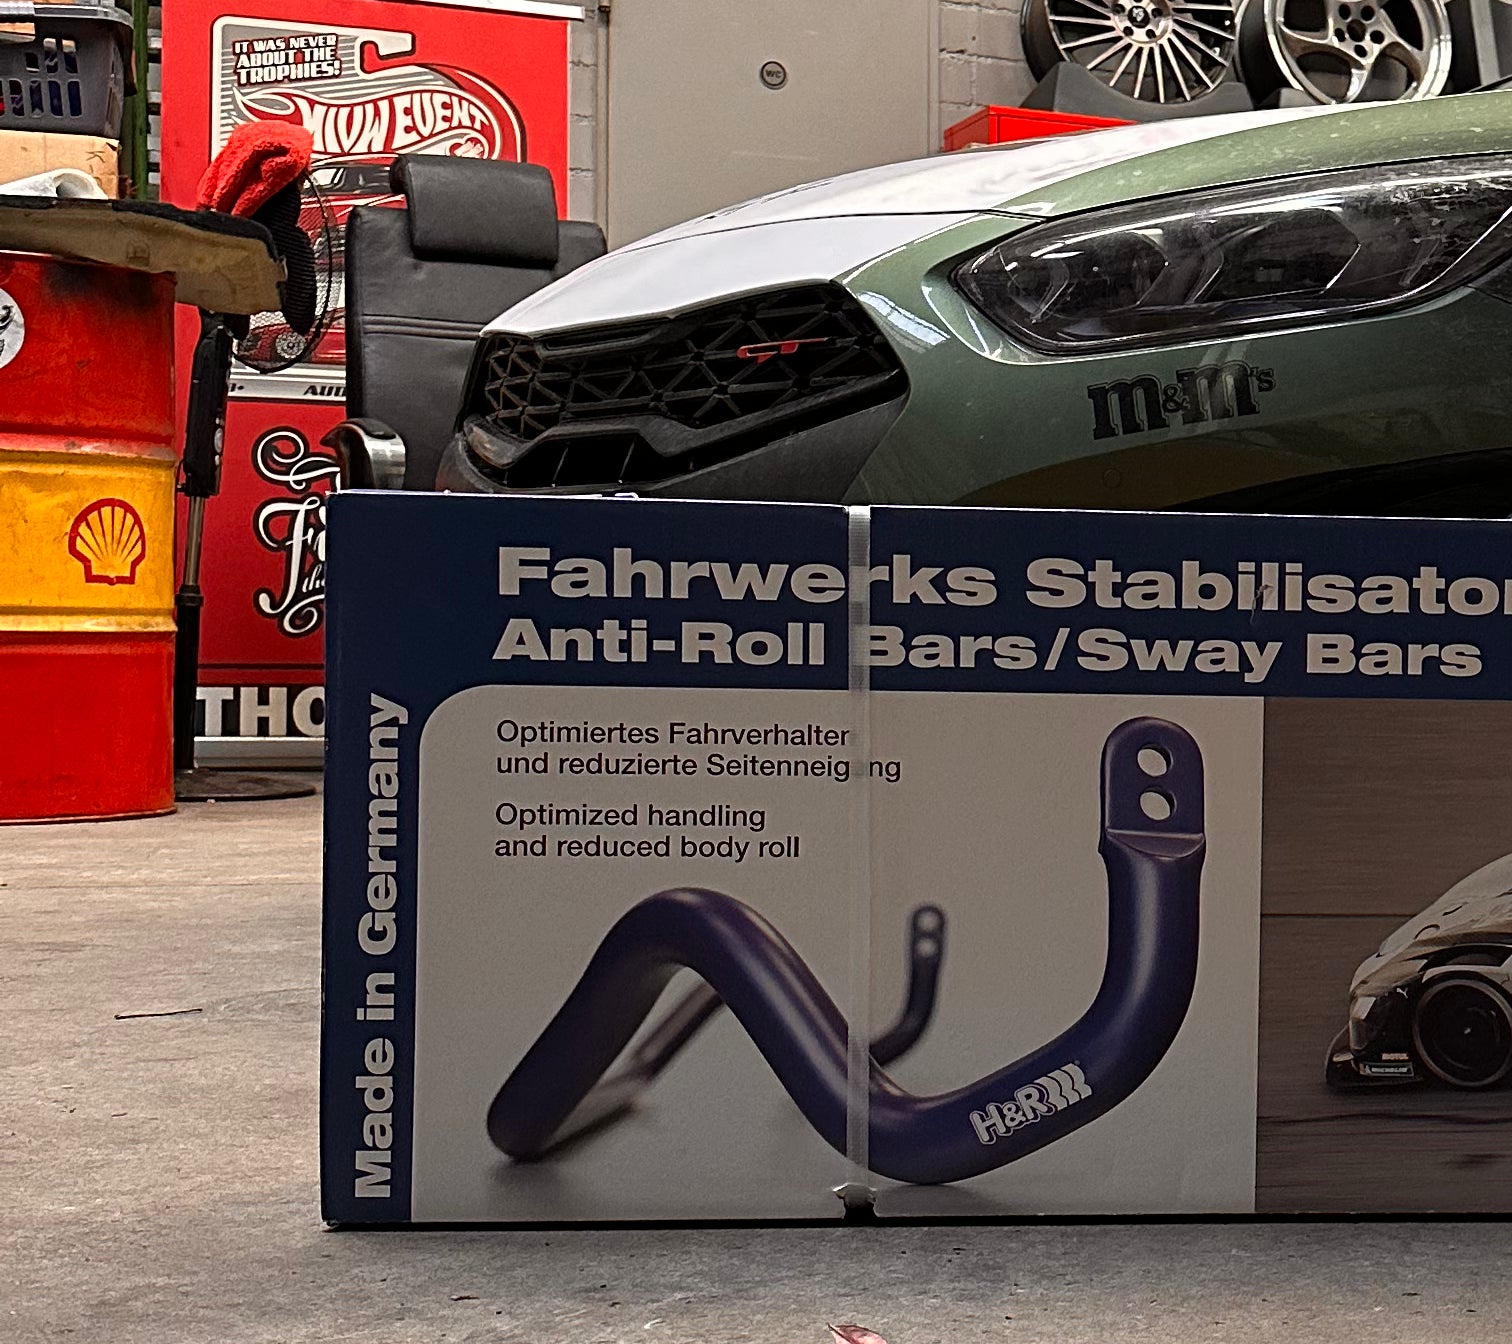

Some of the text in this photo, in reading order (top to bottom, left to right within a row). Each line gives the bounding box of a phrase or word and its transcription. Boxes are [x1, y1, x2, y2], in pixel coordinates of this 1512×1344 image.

[233, 33, 338, 54] IT WAS NEVER
[236, 46, 337, 69] ABOUT THE
[236, 60, 343, 86] TROPHIES!
[765, 69, 783, 79] WC
[498, 546, 998, 606] Fahrwerks
[492, 618, 826, 667] Anti-Roll
[1306, 632, 1484, 678] Bars
[496, 719, 660, 748] Optimiertes
[497, 752, 901, 783] und reduzierte Seitenneigng
[495, 802, 767, 833] Optimized handling
[494, 835, 801, 863] and reduced body roll
[354, 692, 410, 1199] Made in Germany
[969, 1083, 1056, 1145] H&R
